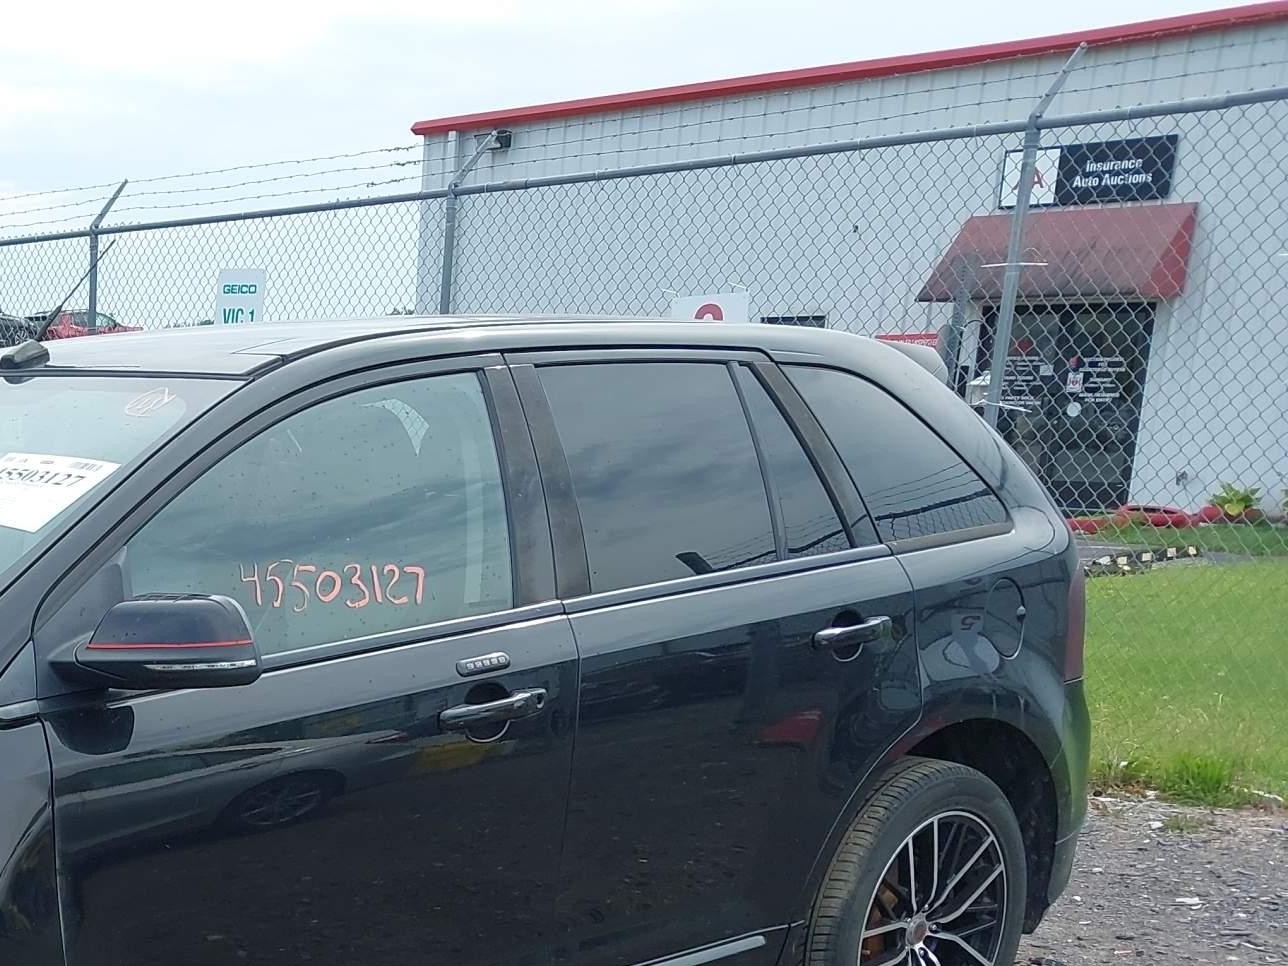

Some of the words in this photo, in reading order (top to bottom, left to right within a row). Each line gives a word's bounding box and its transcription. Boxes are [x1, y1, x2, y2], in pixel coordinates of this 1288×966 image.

[1086, 157, 1144, 173] Insurance
[1072, 174, 1100, 188] Auto
[1101, 171, 1153, 187] Auctions
[223, 284, 257, 294] GEICO
[239, 559, 426, 612] 45503127
